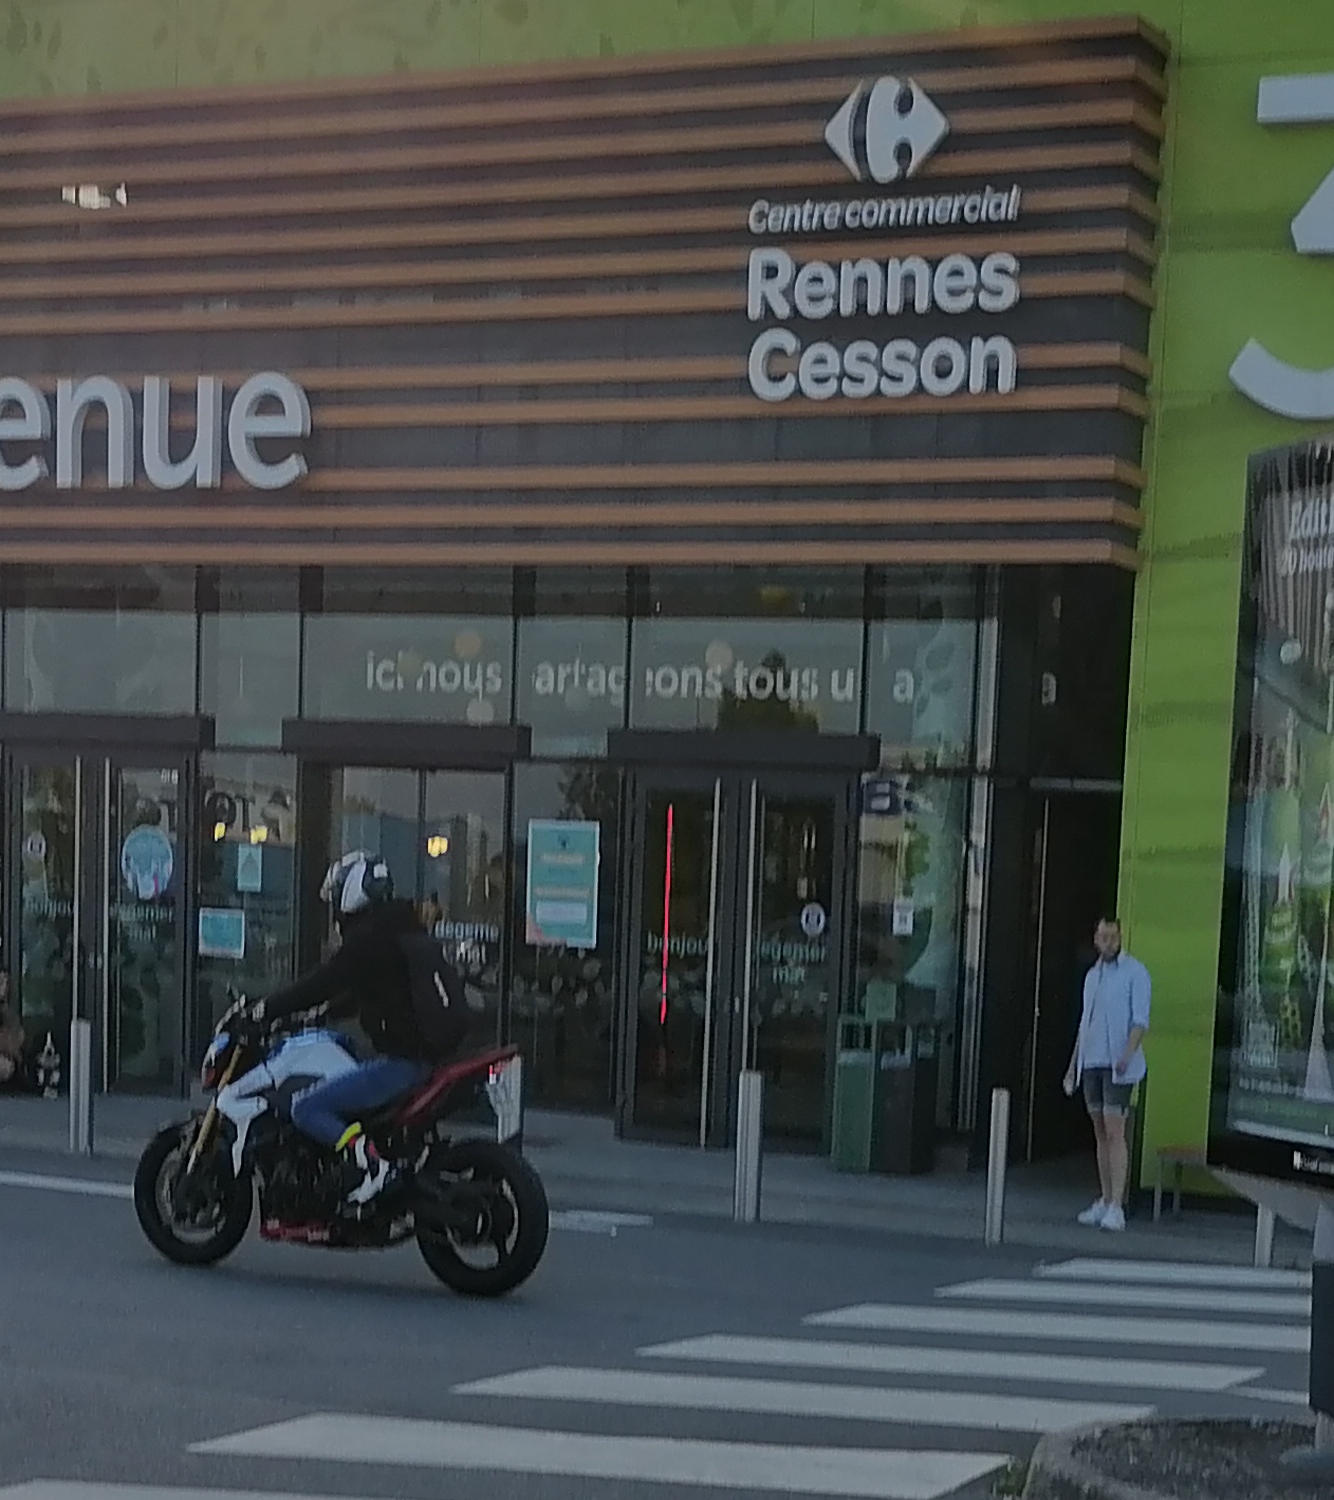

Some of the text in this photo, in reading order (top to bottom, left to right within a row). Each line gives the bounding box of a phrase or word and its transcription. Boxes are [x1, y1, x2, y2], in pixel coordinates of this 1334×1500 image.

[748, 184, 1021, 235] Centre commercial
[747, 246, 1021, 322] Rennes
[747, 326, 1018, 402] Cesson
